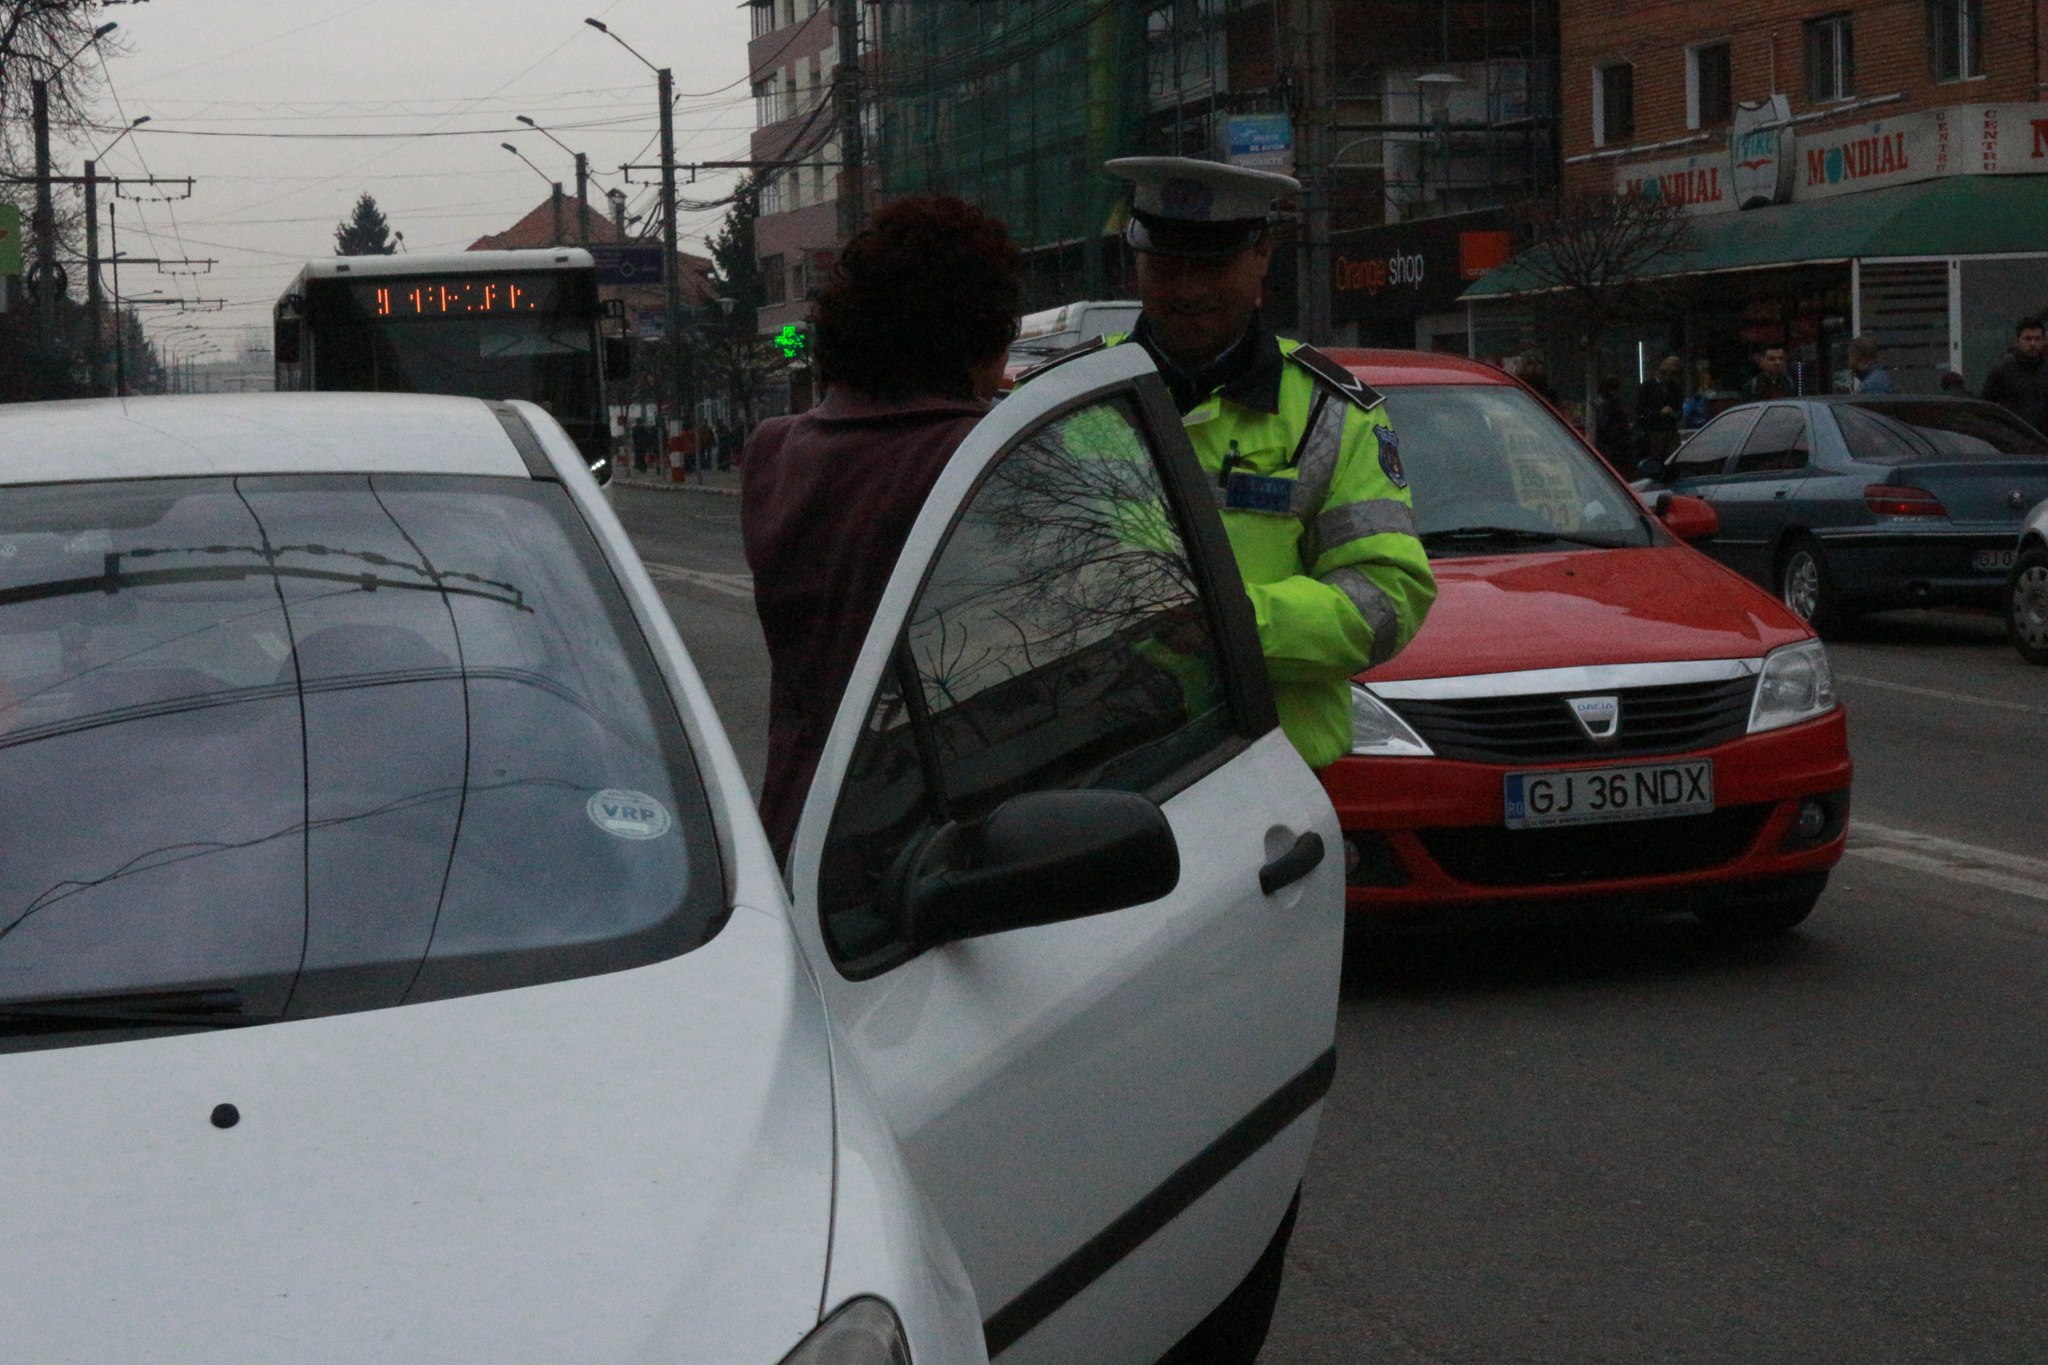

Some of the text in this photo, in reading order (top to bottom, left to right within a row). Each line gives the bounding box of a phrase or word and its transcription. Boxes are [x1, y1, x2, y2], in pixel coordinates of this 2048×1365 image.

[1807, 132, 1909, 187] MONDIAL
[1935, 111, 1949, 173] CENTRU
[1982, 110, 1998, 172] CENTRU
[1336, 247, 1424, 296] Orange shop
[1979, 551, 1998, 567] GJ
[1577, 702, 1614, 711] DACIA
[602, 803, 656, 822] VRP
[1508, 802, 1524, 818] RO
[1529, 777, 1573, 814] GJ
